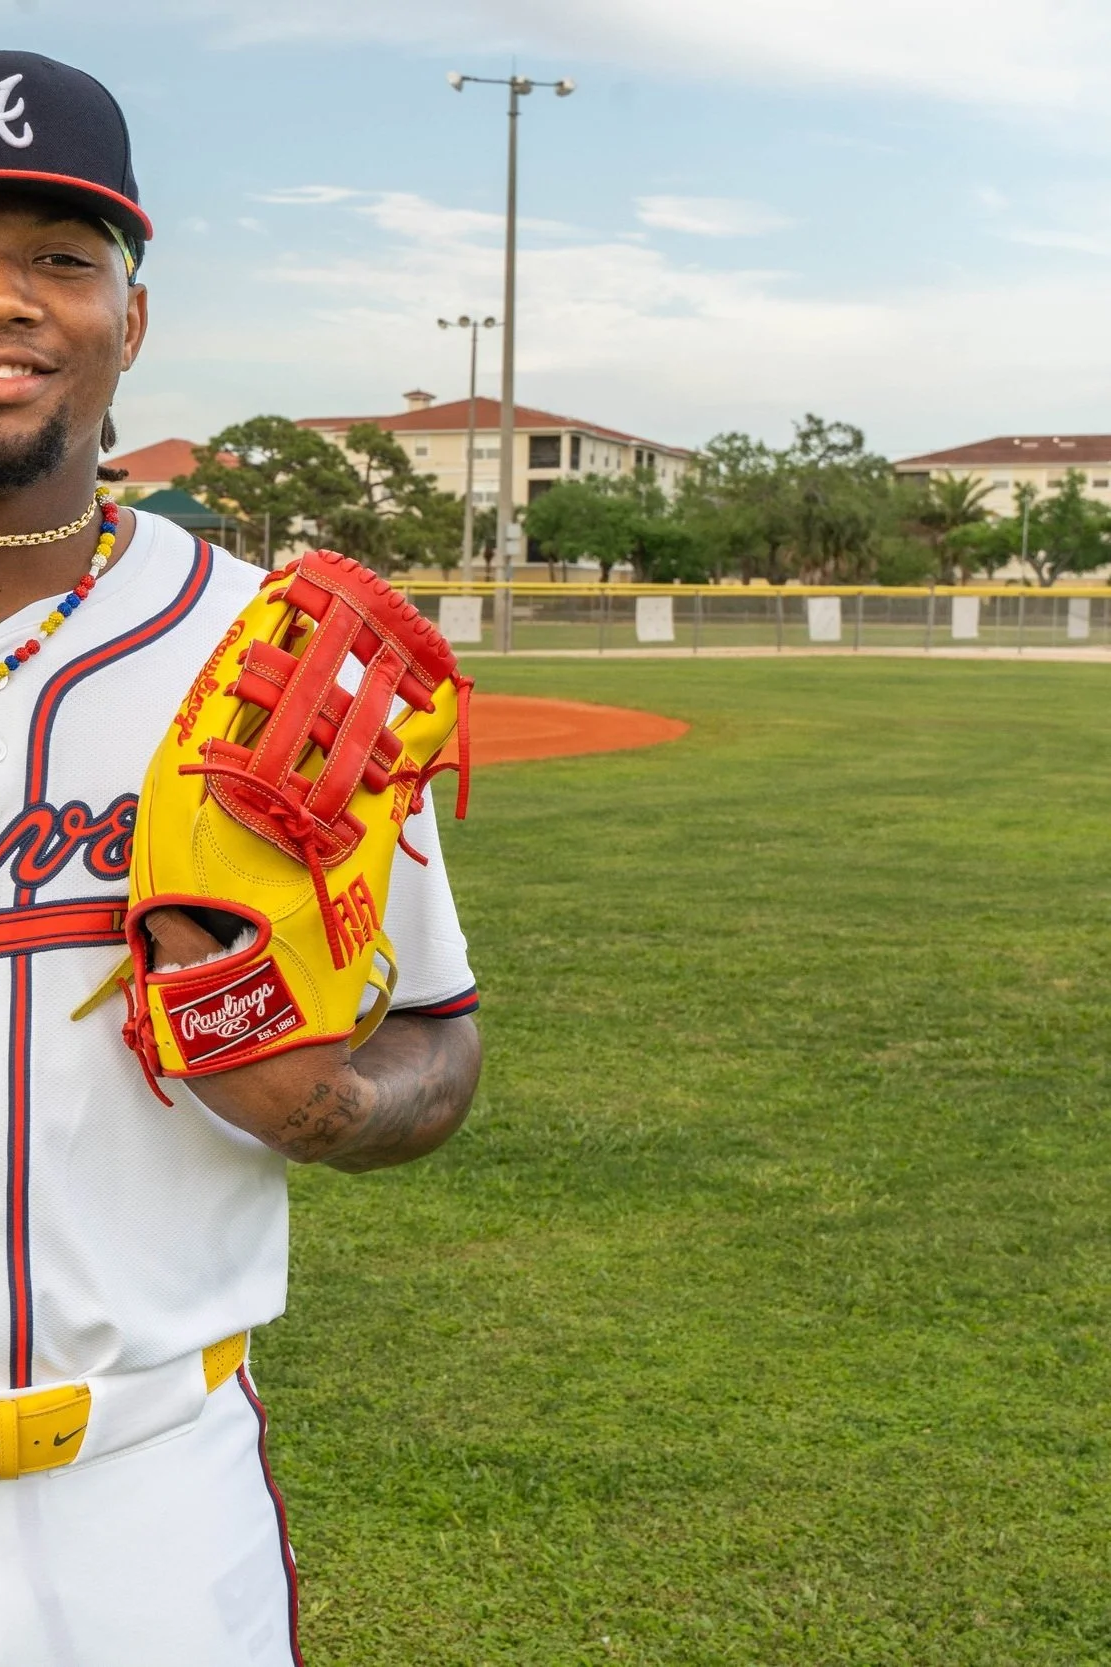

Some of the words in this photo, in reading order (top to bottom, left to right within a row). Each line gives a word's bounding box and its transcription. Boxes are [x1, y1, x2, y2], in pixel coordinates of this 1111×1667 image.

[180, 983, 276, 1040] Rawlings
[256, 1028, 277, 1042] Est.
[276, 1014, 297, 1032] 1887
